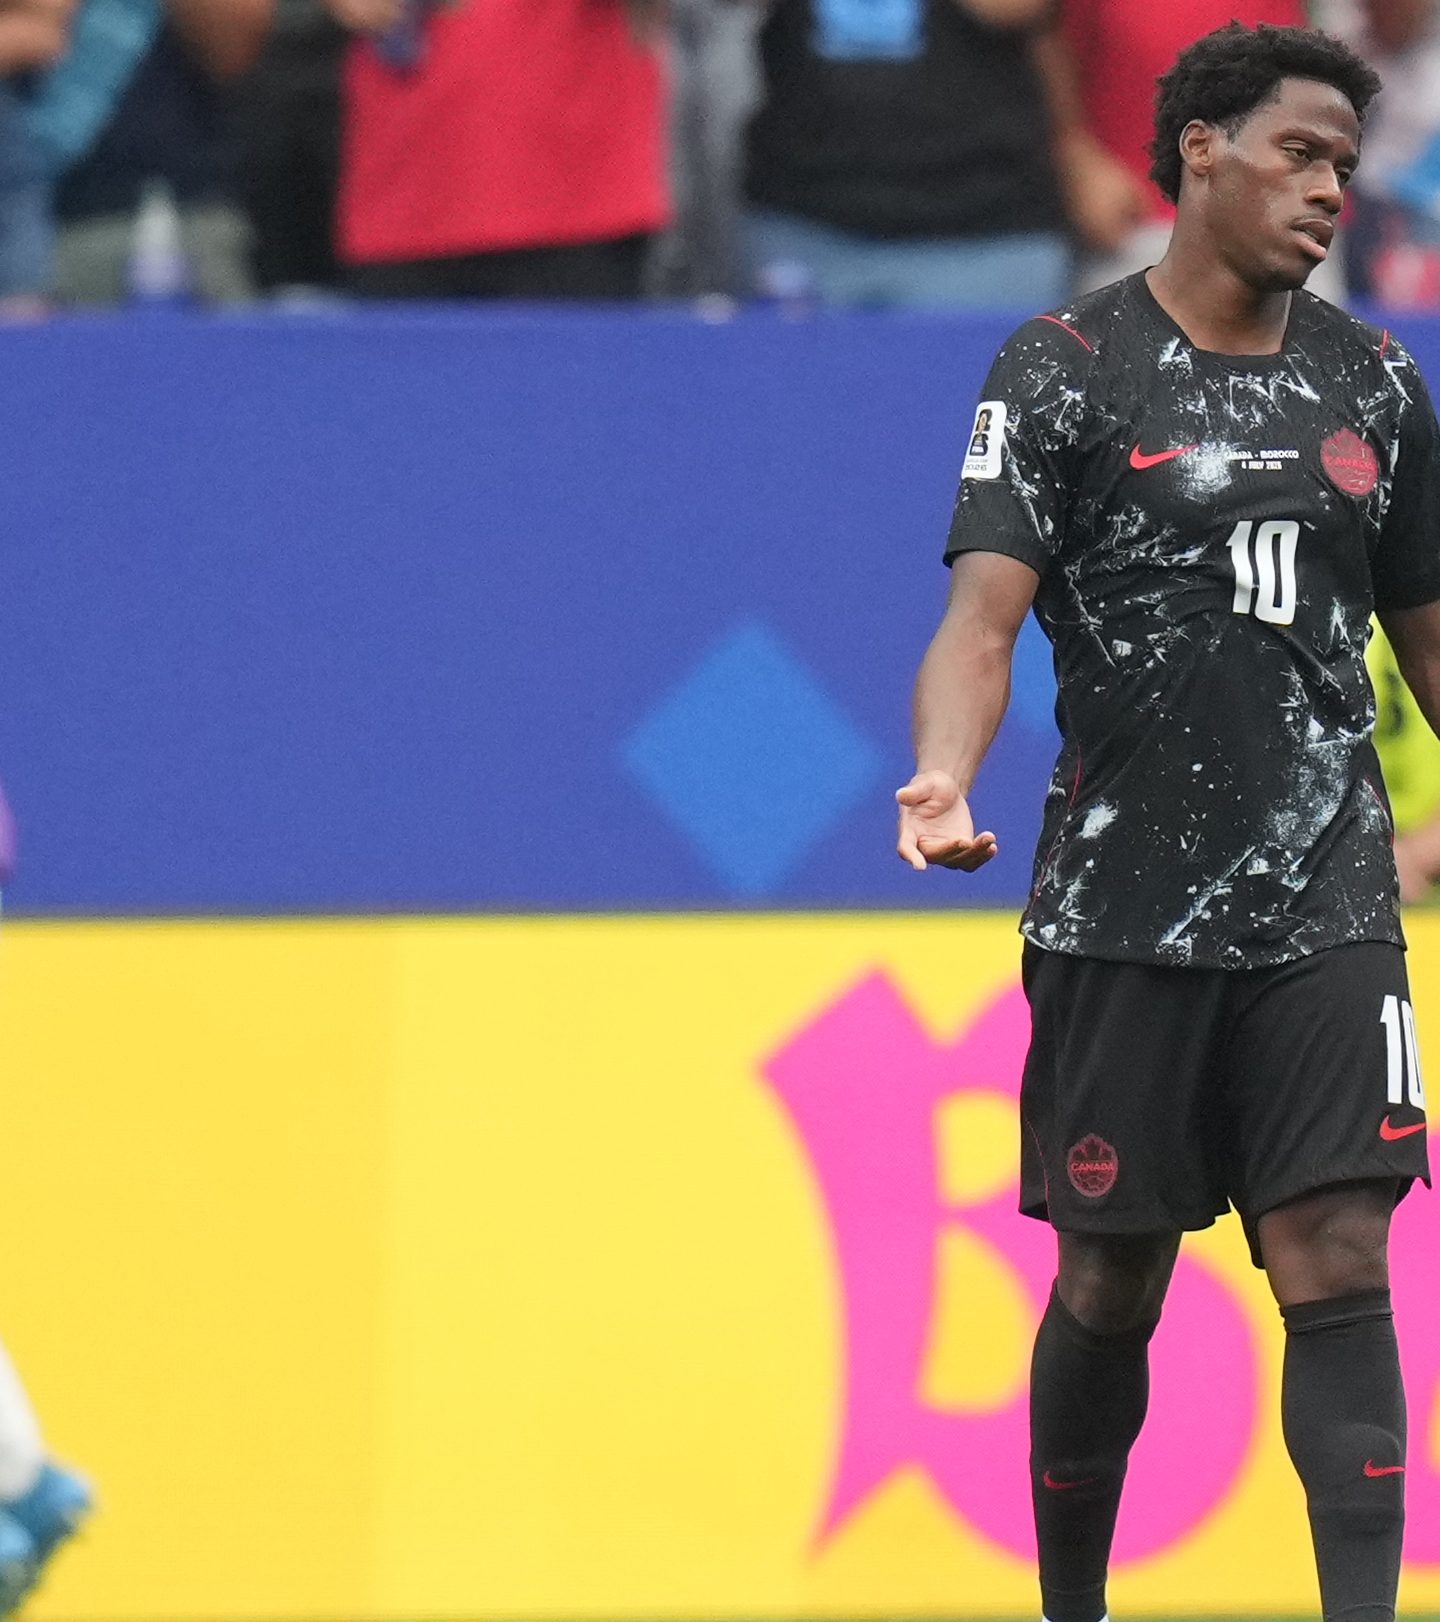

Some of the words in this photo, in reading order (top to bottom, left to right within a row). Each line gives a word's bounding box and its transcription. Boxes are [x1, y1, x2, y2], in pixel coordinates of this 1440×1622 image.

[1260, 449, 1300, 460] MOROCCO
[1226, 520, 1300, 625] 10
[1379, 994, 1426, 1112] 10
[1071, 1161, 1115, 1173] CANADA
